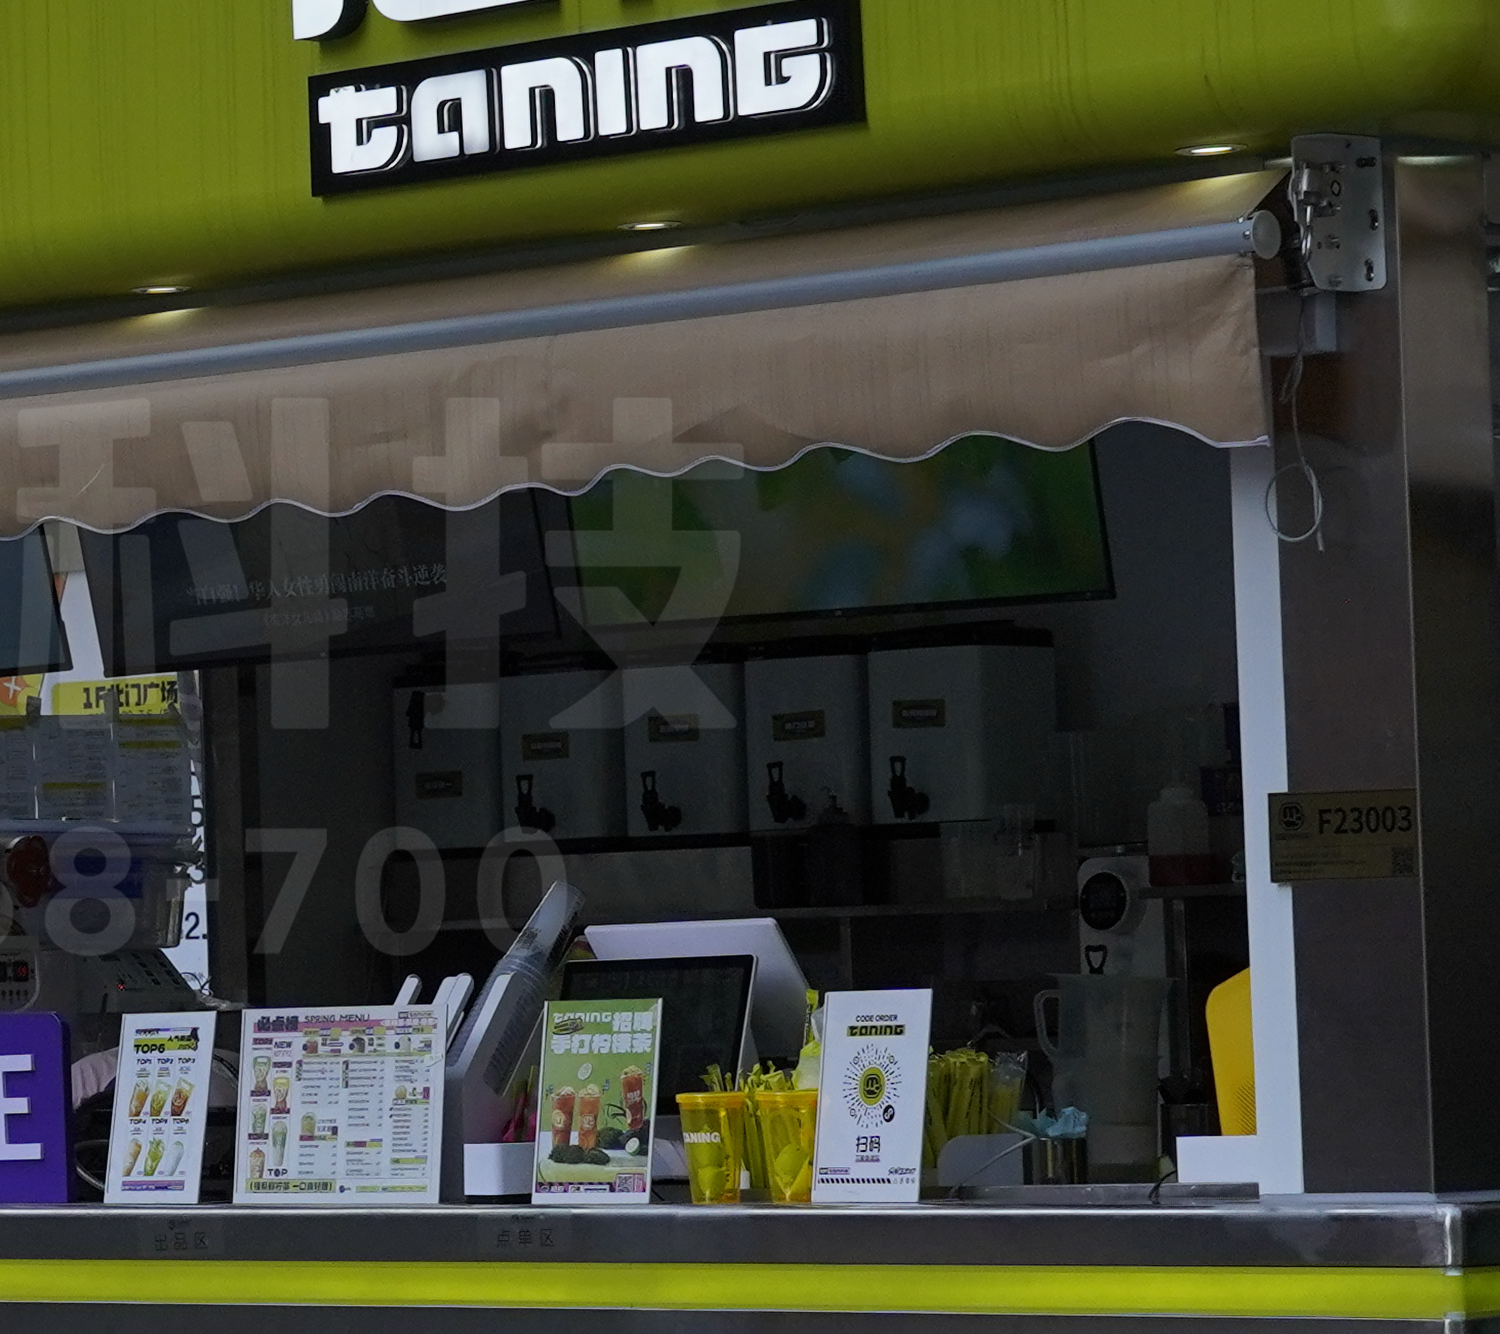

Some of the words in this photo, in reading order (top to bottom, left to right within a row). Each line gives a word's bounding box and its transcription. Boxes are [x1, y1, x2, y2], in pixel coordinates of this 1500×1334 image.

[1318, 805, 1412, 835] F23003
[340, 1014, 370, 1023] MENU
[856, 1014, 874, 1022] CODE
[875, 1014, 898, 1022] ORDER
[134, 1044, 166, 1055] TOP6
[550, 1033, 652, 1055] 手打柠檬茶
[683, 1132, 721, 1143] ANING
[856, 1135, 881, 1154] 扫码
